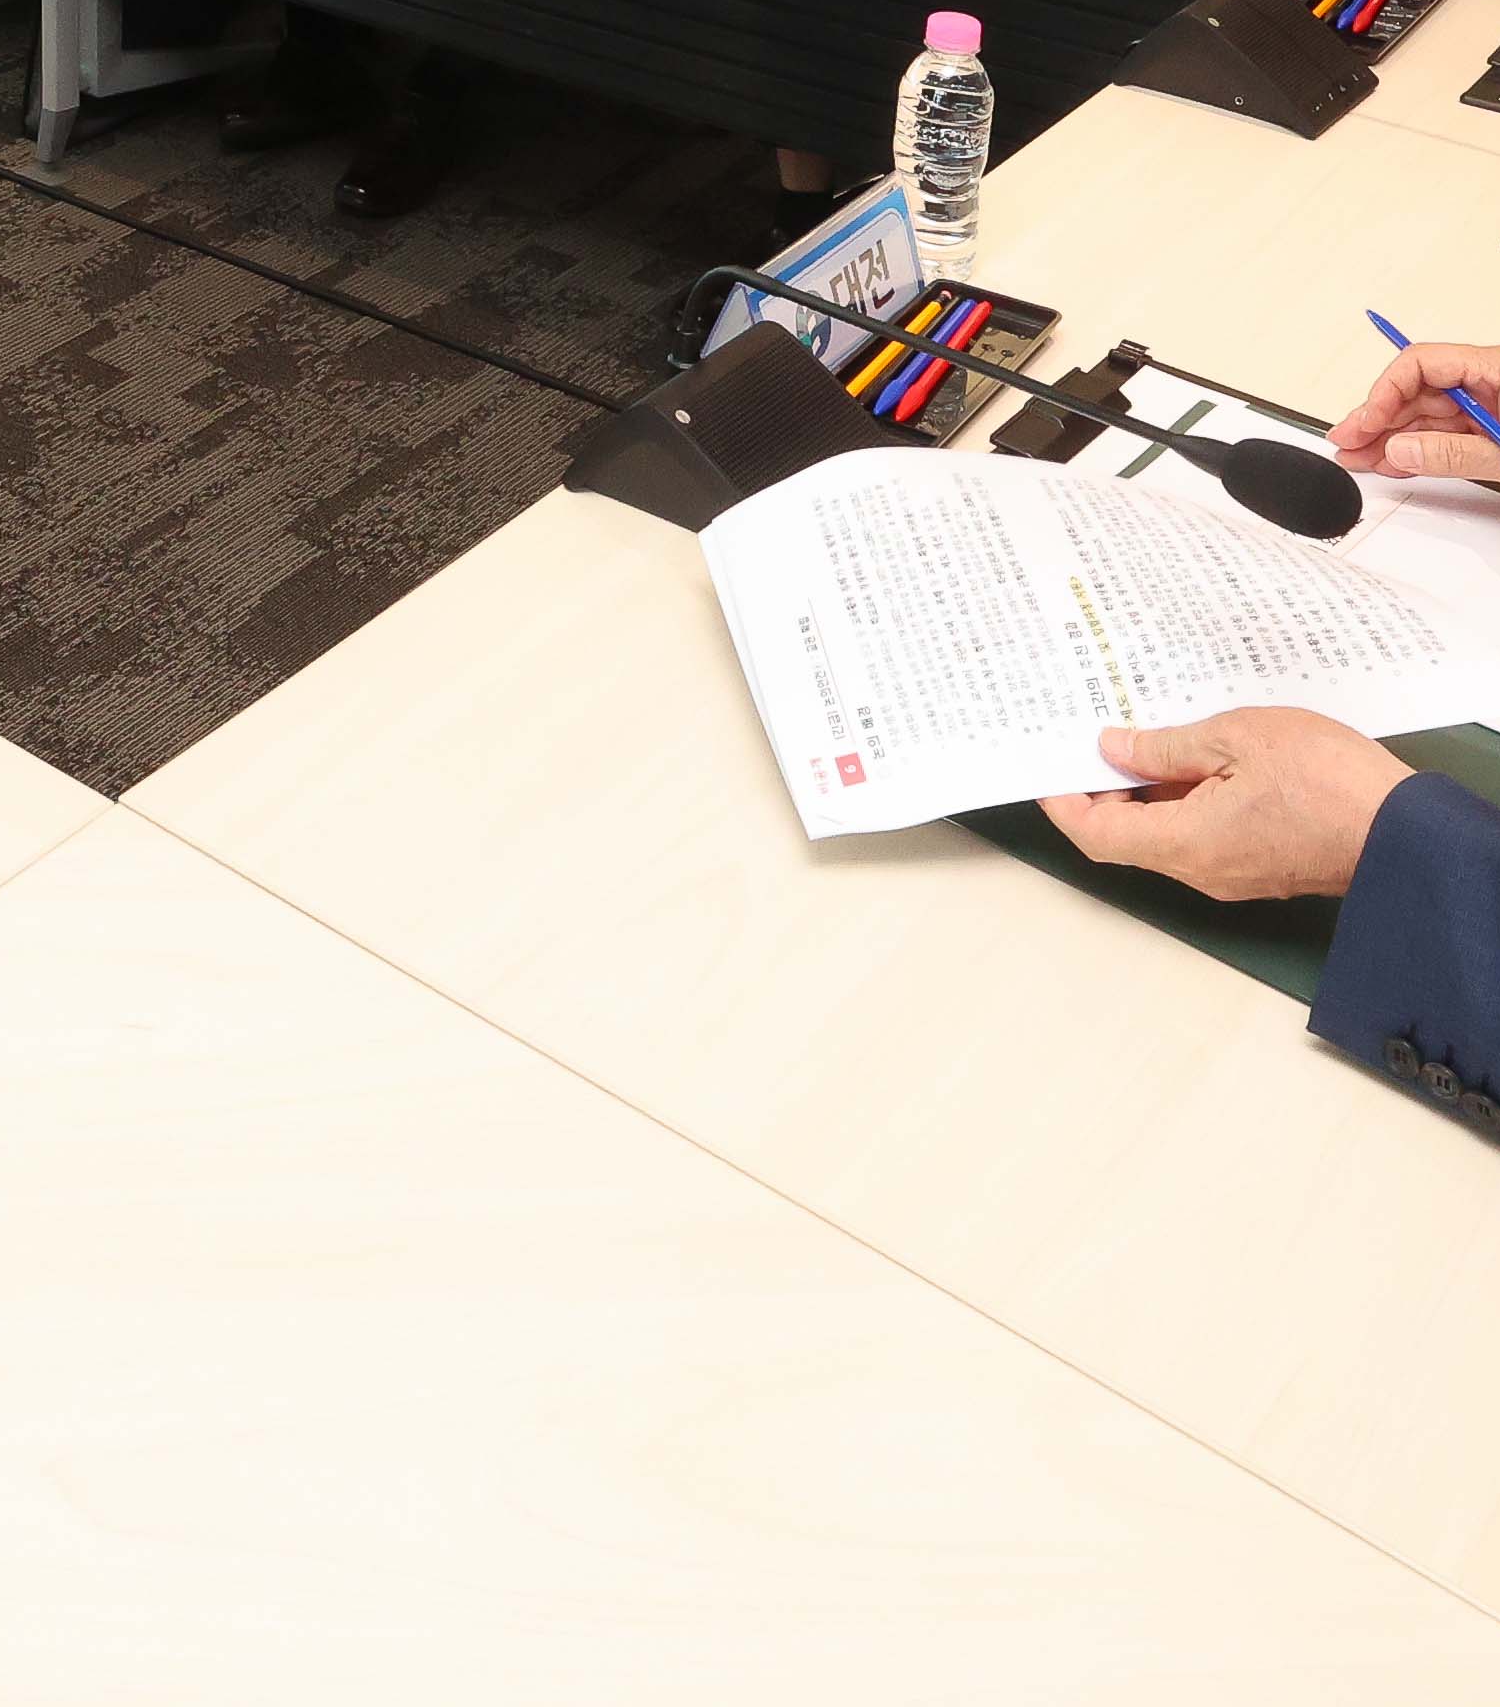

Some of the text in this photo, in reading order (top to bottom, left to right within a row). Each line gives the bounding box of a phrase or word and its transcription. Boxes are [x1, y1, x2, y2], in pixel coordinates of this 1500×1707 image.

[829, 239, 896, 320] 대전
[1084, 675, 1110, 720] 그간의
[855, 704, 887, 760] 논의 배경
